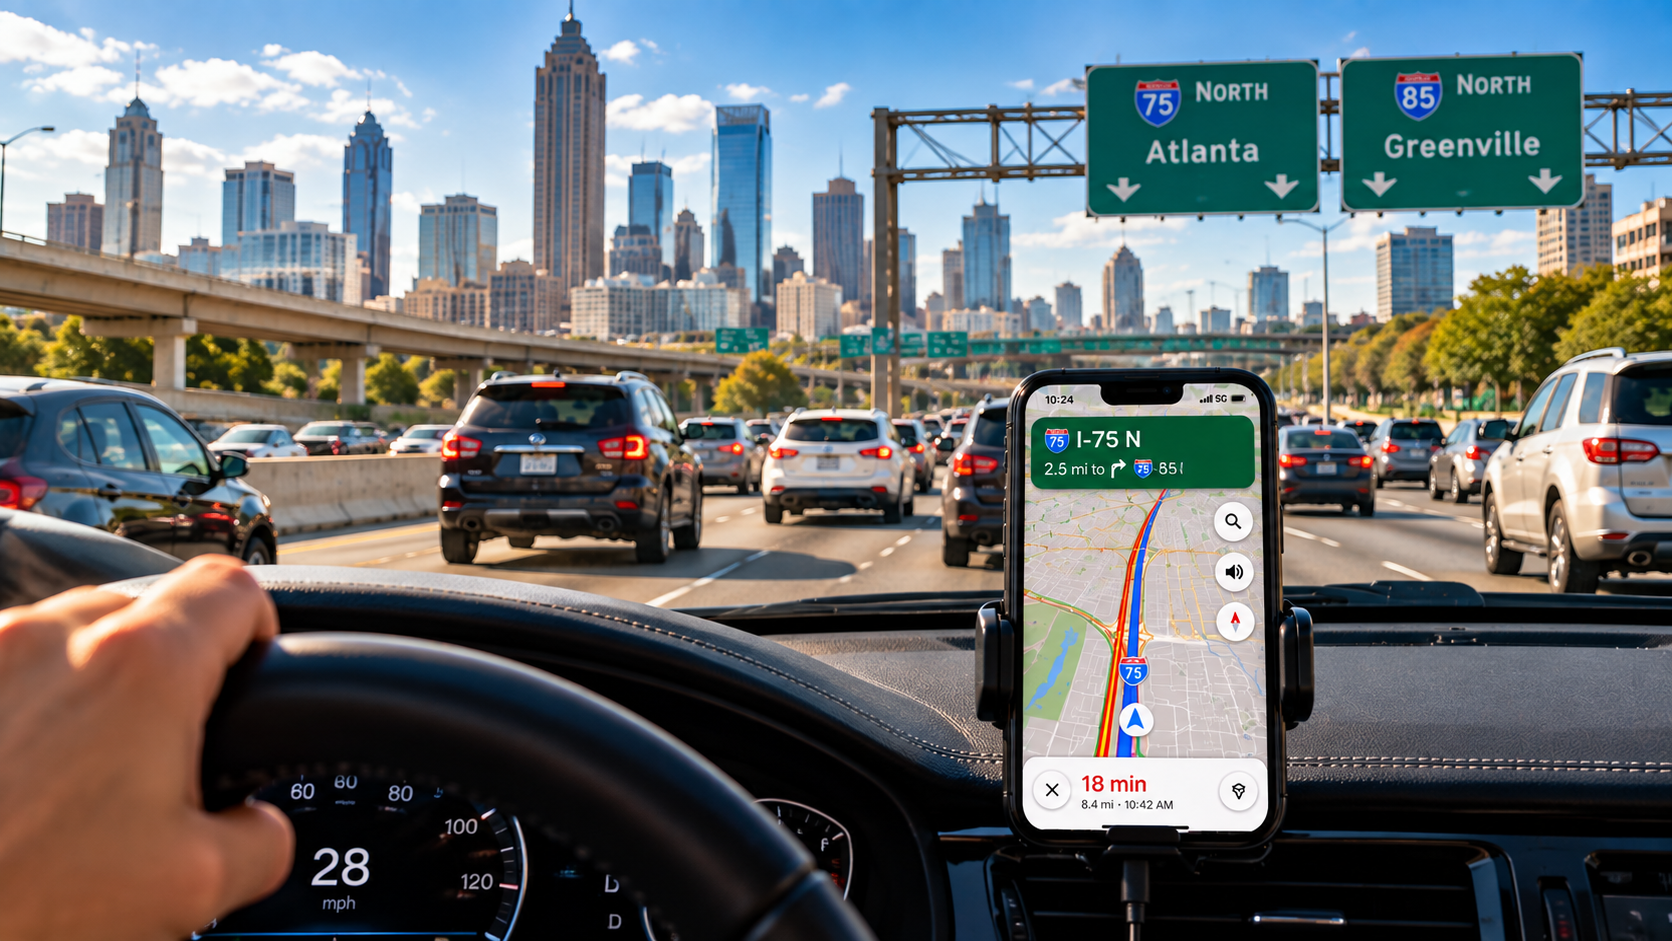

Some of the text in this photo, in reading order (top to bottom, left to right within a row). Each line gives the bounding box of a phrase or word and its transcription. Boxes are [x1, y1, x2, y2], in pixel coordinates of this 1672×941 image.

[1142, 81, 1269, 117] 75 NORTH
[1402, 74, 1532, 110] 85 NORTH
[1145, 138, 1260, 164] Atlanta
[1384, 130, 1541, 159] Greenville
[1045, 395, 1074, 405] 10:24
[1050, 430, 1141, 448] 75 I-75 N
[1044, 462, 1067, 476] 2.5
[1071, 463, 1088, 476] mi
[1091, 463, 1105, 476] to
[1125, 666, 1142, 680] 75
[290, 782, 315, 800] 60
[1081, 774, 1147, 793] 18 min
[388, 785, 413, 802] 80
[1081, 799, 1174, 810] 8.4 mi 10:42 AM
[445, 818, 478, 835] 100
[311, 847, 370, 886] 28
[461, 872, 494, 890] 120
[322, 894, 356, 913] mph
[607, 913, 623, 930] D
